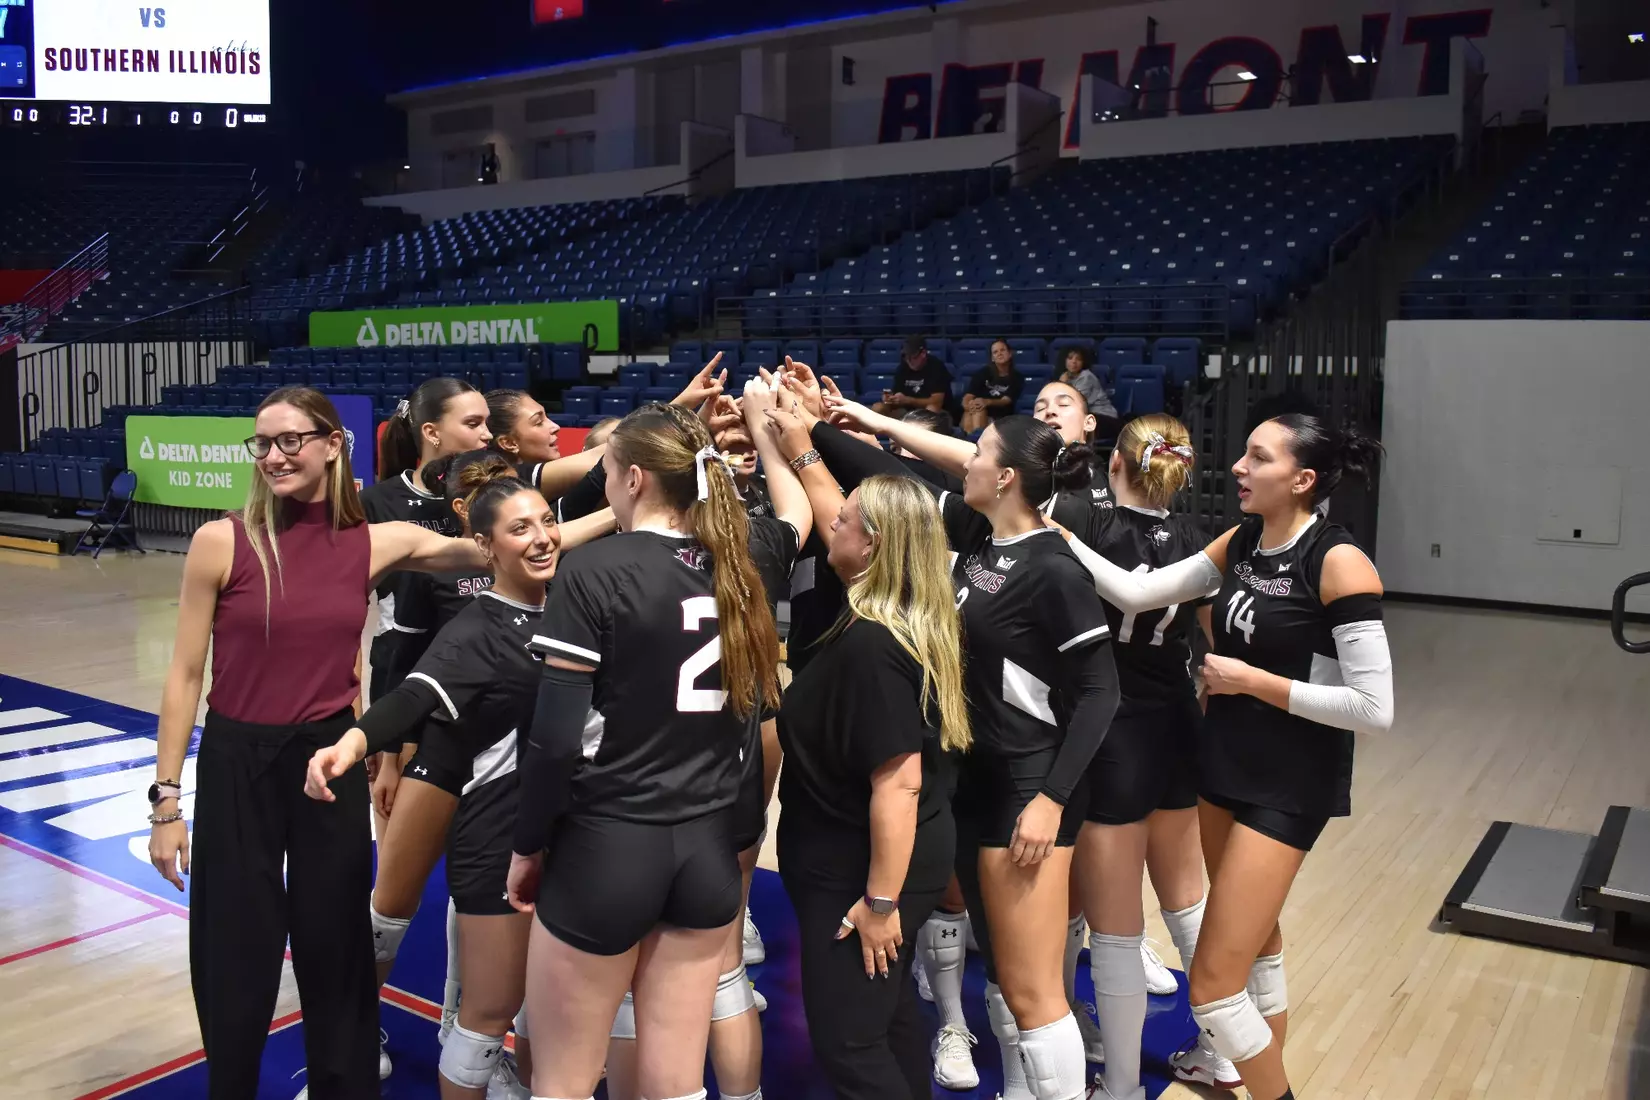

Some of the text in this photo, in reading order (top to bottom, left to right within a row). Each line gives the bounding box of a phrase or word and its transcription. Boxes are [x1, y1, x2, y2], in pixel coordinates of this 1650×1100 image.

[139, 7, 166, 28] VS
[44, 47, 261, 75] SOUTHERN ILLINOIS
[877, 9, 1493, 150] BEMONT
[14, 108, 22, 121] 0
[29, 109, 38, 122] 0
[170, 111, 179, 124] 0
[193, 111, 202, 124] 0
[225, 108, 238, 127] 0
[385, 317, 540, 347] DELTA DENTAL
[158, 442, 199, 463] DELTA
[169, 469, 233, 489] KID ZONE
[1225, 590, 1256, 645] 14
[676, 595, 730, 714] 2
